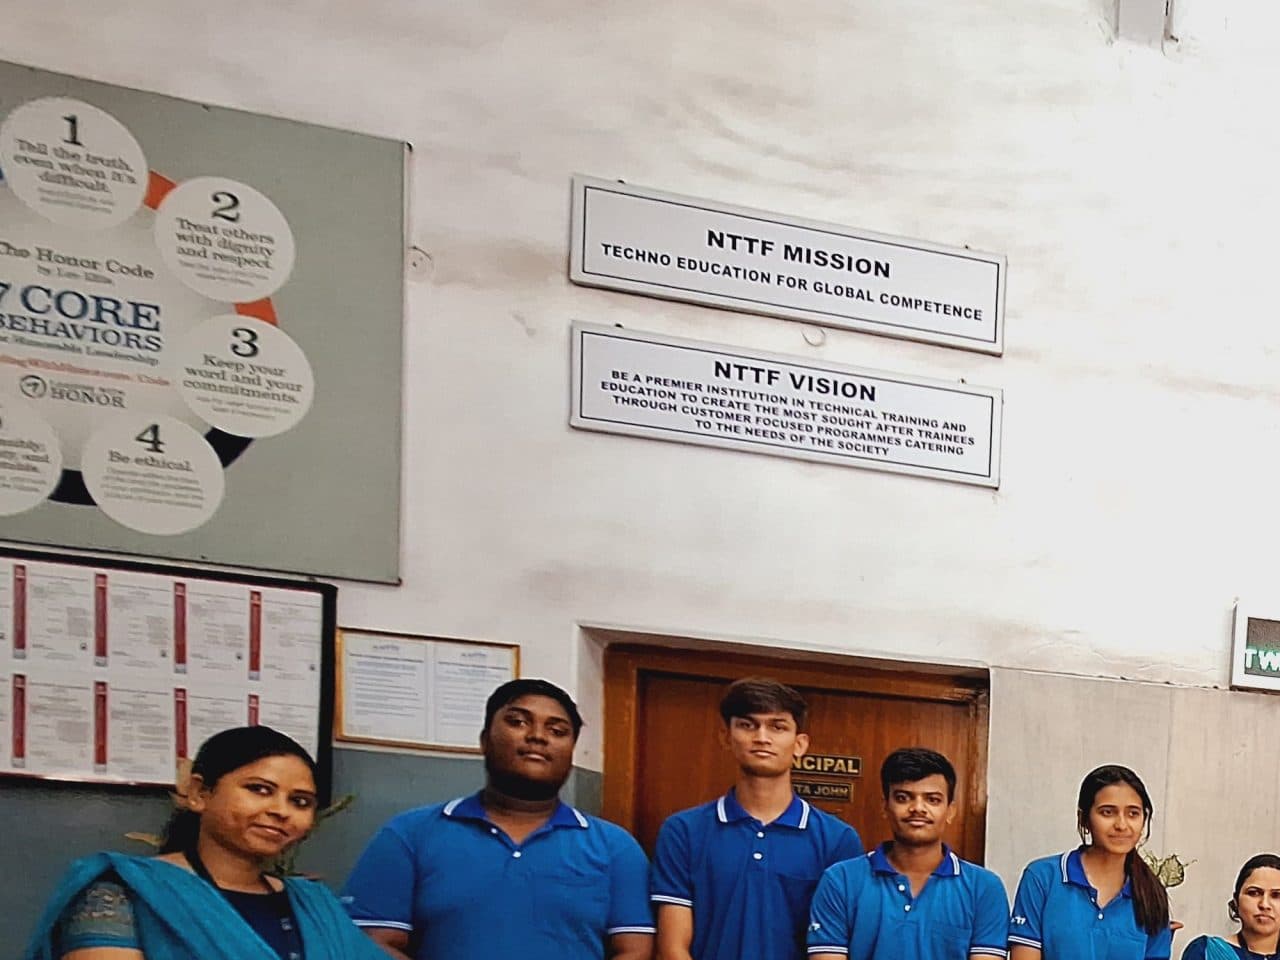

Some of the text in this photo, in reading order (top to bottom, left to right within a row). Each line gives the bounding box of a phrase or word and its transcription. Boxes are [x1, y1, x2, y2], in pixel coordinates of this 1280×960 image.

[62, 114, 84, 147] 1
[13, 155, 54, 169] even
[58, 162, 106, 179] when
[53, 147, 80, 160] the
[212, 191, 240, 222] 2
[175, 232, 274, 259] with dignity
[176, 217, 275, 244] Treat others
[36, 247, 101, 270] Honor
[106, 259, 155, 279] Code
[177, 246, 207, 258] and
[707, 229, 890, 279] NTTF MISSION
[602, 243, 984, 321] TECHNO EDUCATION FOR GLOBAL COMPETENCE
[21, 285, 161, 333] CORE
[231, 327, 259, 358] 3
[184, 366, 226, 381] word
[231, 374, 262, 387] and
[266, 379, 303, 393] your
[203, 353, 286, 377] Keep your
[714, 360, 876, 402] NTTF VISION
[51, 387, 126, 408] HONOR
[611, 370, 967, 433] BE A PREMIER INSTITUTION IN TECHNICAL TRAINING AND
[600, 381, 975, 446] EDUCATION TO CREATE THE MOST SOUGHT AFTER TRAINEES
[612, 395, 965, 456] THROUGH CUSTOMER FOCUSED PROGRAMMES CATERING
[135, 424, 165, 454] 4
[694, 419, 890, 456] TO THE NEEDS OF THE SOCIETY
[107, 450, 130, 464] Be
